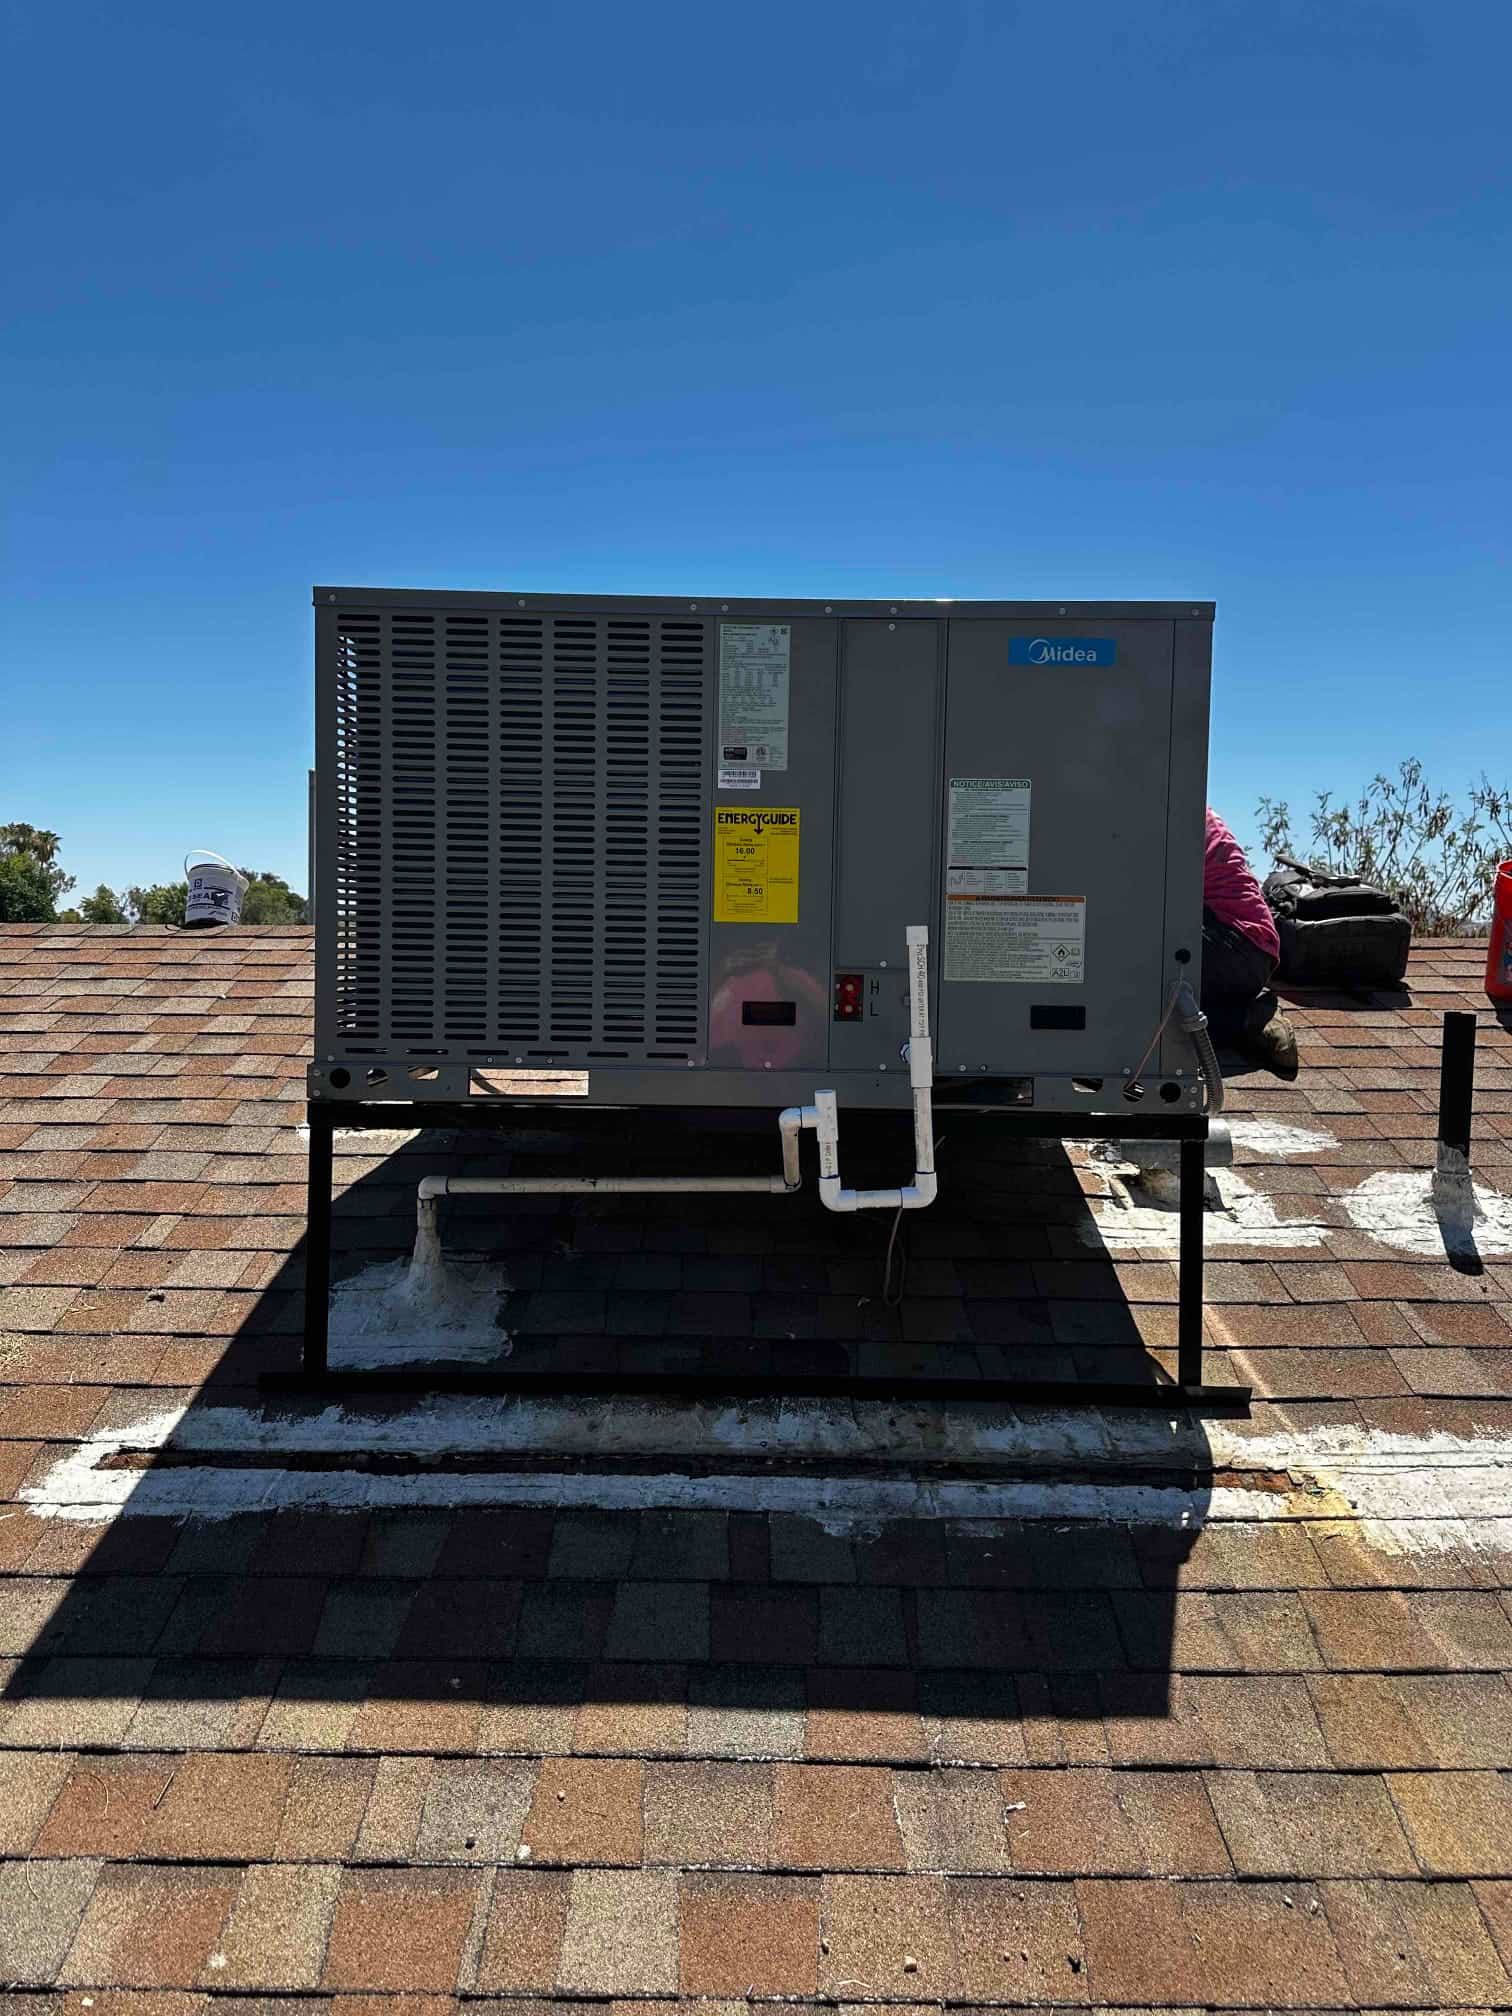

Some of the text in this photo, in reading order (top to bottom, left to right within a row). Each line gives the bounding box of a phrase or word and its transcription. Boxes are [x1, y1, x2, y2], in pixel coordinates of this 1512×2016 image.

[1038, 646, 1097, 662] Midea
[718, 812, 797, 825] ENERGYGUIDE
[870, 978, 880, 995] H
[870, 1002, 879, 1016] L
